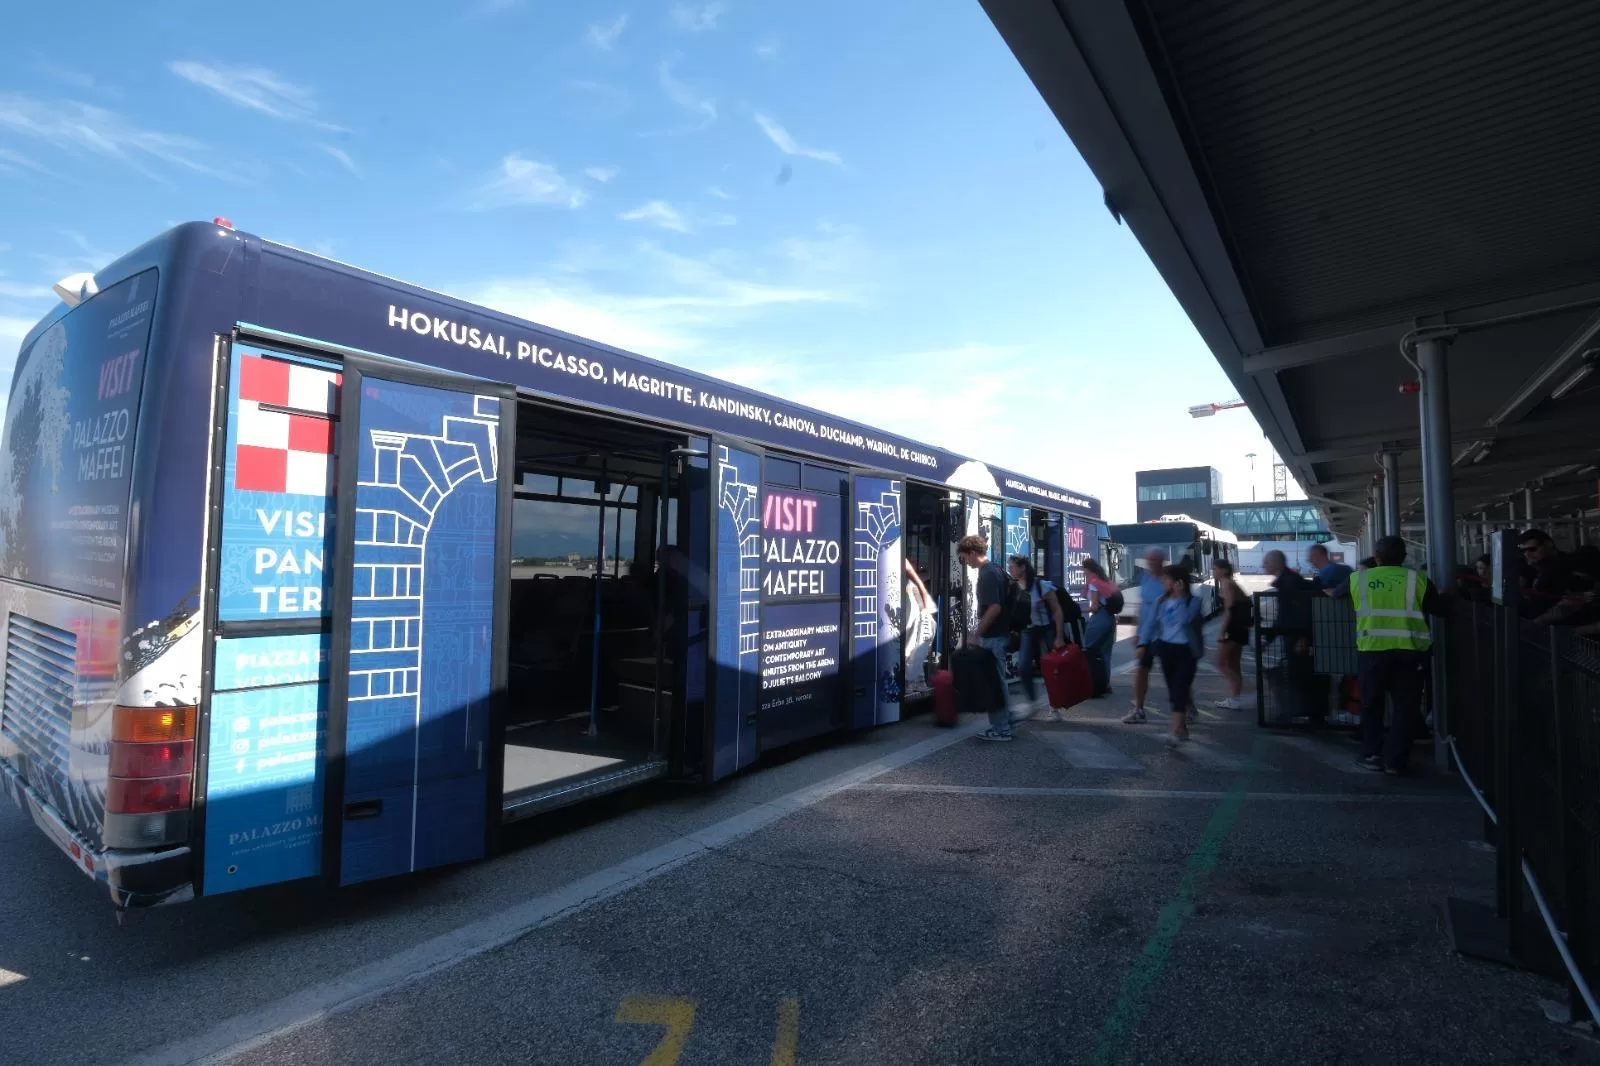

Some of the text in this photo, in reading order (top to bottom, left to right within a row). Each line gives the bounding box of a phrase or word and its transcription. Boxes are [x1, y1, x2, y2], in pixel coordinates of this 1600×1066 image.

[98, 348, 140, 400] VISIT
[388, 304, 938, 469] HOKUSAI, PICASSO, MAGRITTE, KANDINSKY, CANOVA, DUCHAMP, WARHOL, DE CHIRICO,
[73, 408, 129, 451] PALAZZO
[79, 445, 126, 480] MAFFEI
[256, 508, 326, 538] VISI
[763, 537, 840, 564] ALAZZO
[252, 586, 324, 613] TER
[766, 625, 838, 640] EXTRAORDINARY MUSEUM
[775, 639, 807, 651] ANTIQUITY
[235, 651, 310, 672] PIAZZA
[765, 647, 826, 664] CONTEMPORARY ART
[788, 662, 804, 672] FROM
[805, 660, 817, 669] THE
[817, 657, 835, 667] ARENA
[795, 670, 822, 682] BALCONY
[228, 817, 302, 846] PALAZZO
